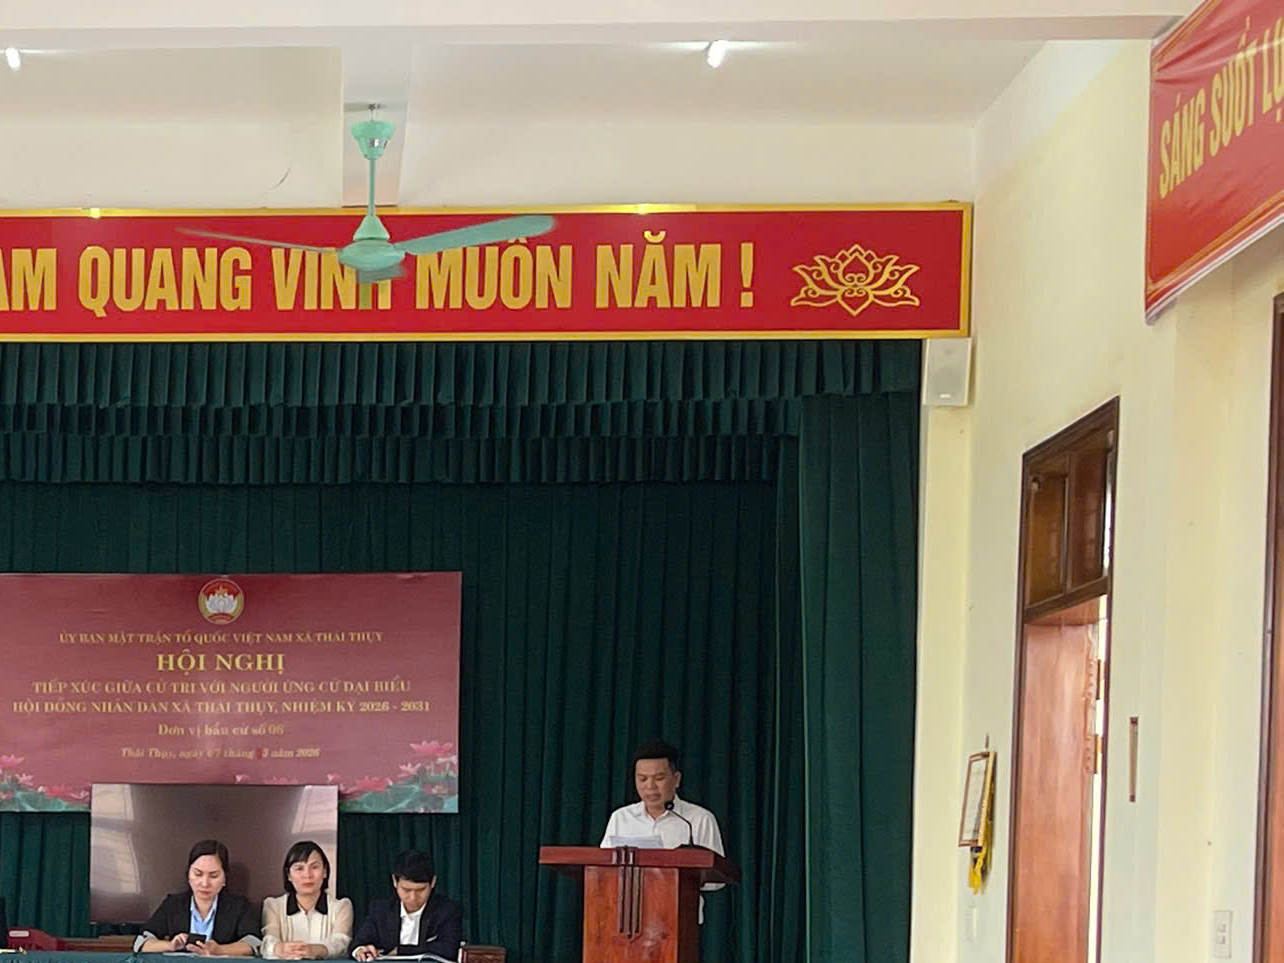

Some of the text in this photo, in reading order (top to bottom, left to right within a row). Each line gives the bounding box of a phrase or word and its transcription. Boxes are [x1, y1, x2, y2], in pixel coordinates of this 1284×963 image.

[1159, 88, 1206, 199] SÁNG
[1209, 16, 1258, 157] SUỐT
[78, 245, 253, 317] QUANG
[271, 246, 392, 310] VINH
[416, 237, 573, 311] MUÔN
[595, 230, 722, 309] NĂM
[740, 241, 754, 308] !
[79, 633, 105, 643] BAN
[138, 631, 172, 645] TRẬN
[175, 628, 192, 643] TỔ
[193, 628, 228, 645] QUỐC
[232, 630, 263, 645] VIỆT
[266, 632, 293, 643] NAM
[156, 648, 285, 676] HỘI NGHỊ
[32, 677, 67, 693] TIẾP
[71, 679, 101, 693] XÚC
[104, 679, 142, 693] GIỮA
[145, 678, 167, 694] CỬ
[172, 682, 196, 693] TRI
[200, 679, 226, 694] VỚI
[282, 679, 316, 693] ỨNG
[318, 678, 340, 693] CỬ
[343, 681, 370, 695] ĐẠI
[374, 675, 411, 693] BIỂU
[12, 698, 40, 715] HỘI
[44, 697, 87, 713] ĐỒNG
[91, 698, 133, 713] NHÂN
[137, 699, 169, 713] DÂN
[282, 699, 332, 714] NHIỆM
[359, 701, 390, 712] 2026
[400, 701, 430, 712] 2031
[158, 721, 285, 739] Đơn vị bầu cử số 06
